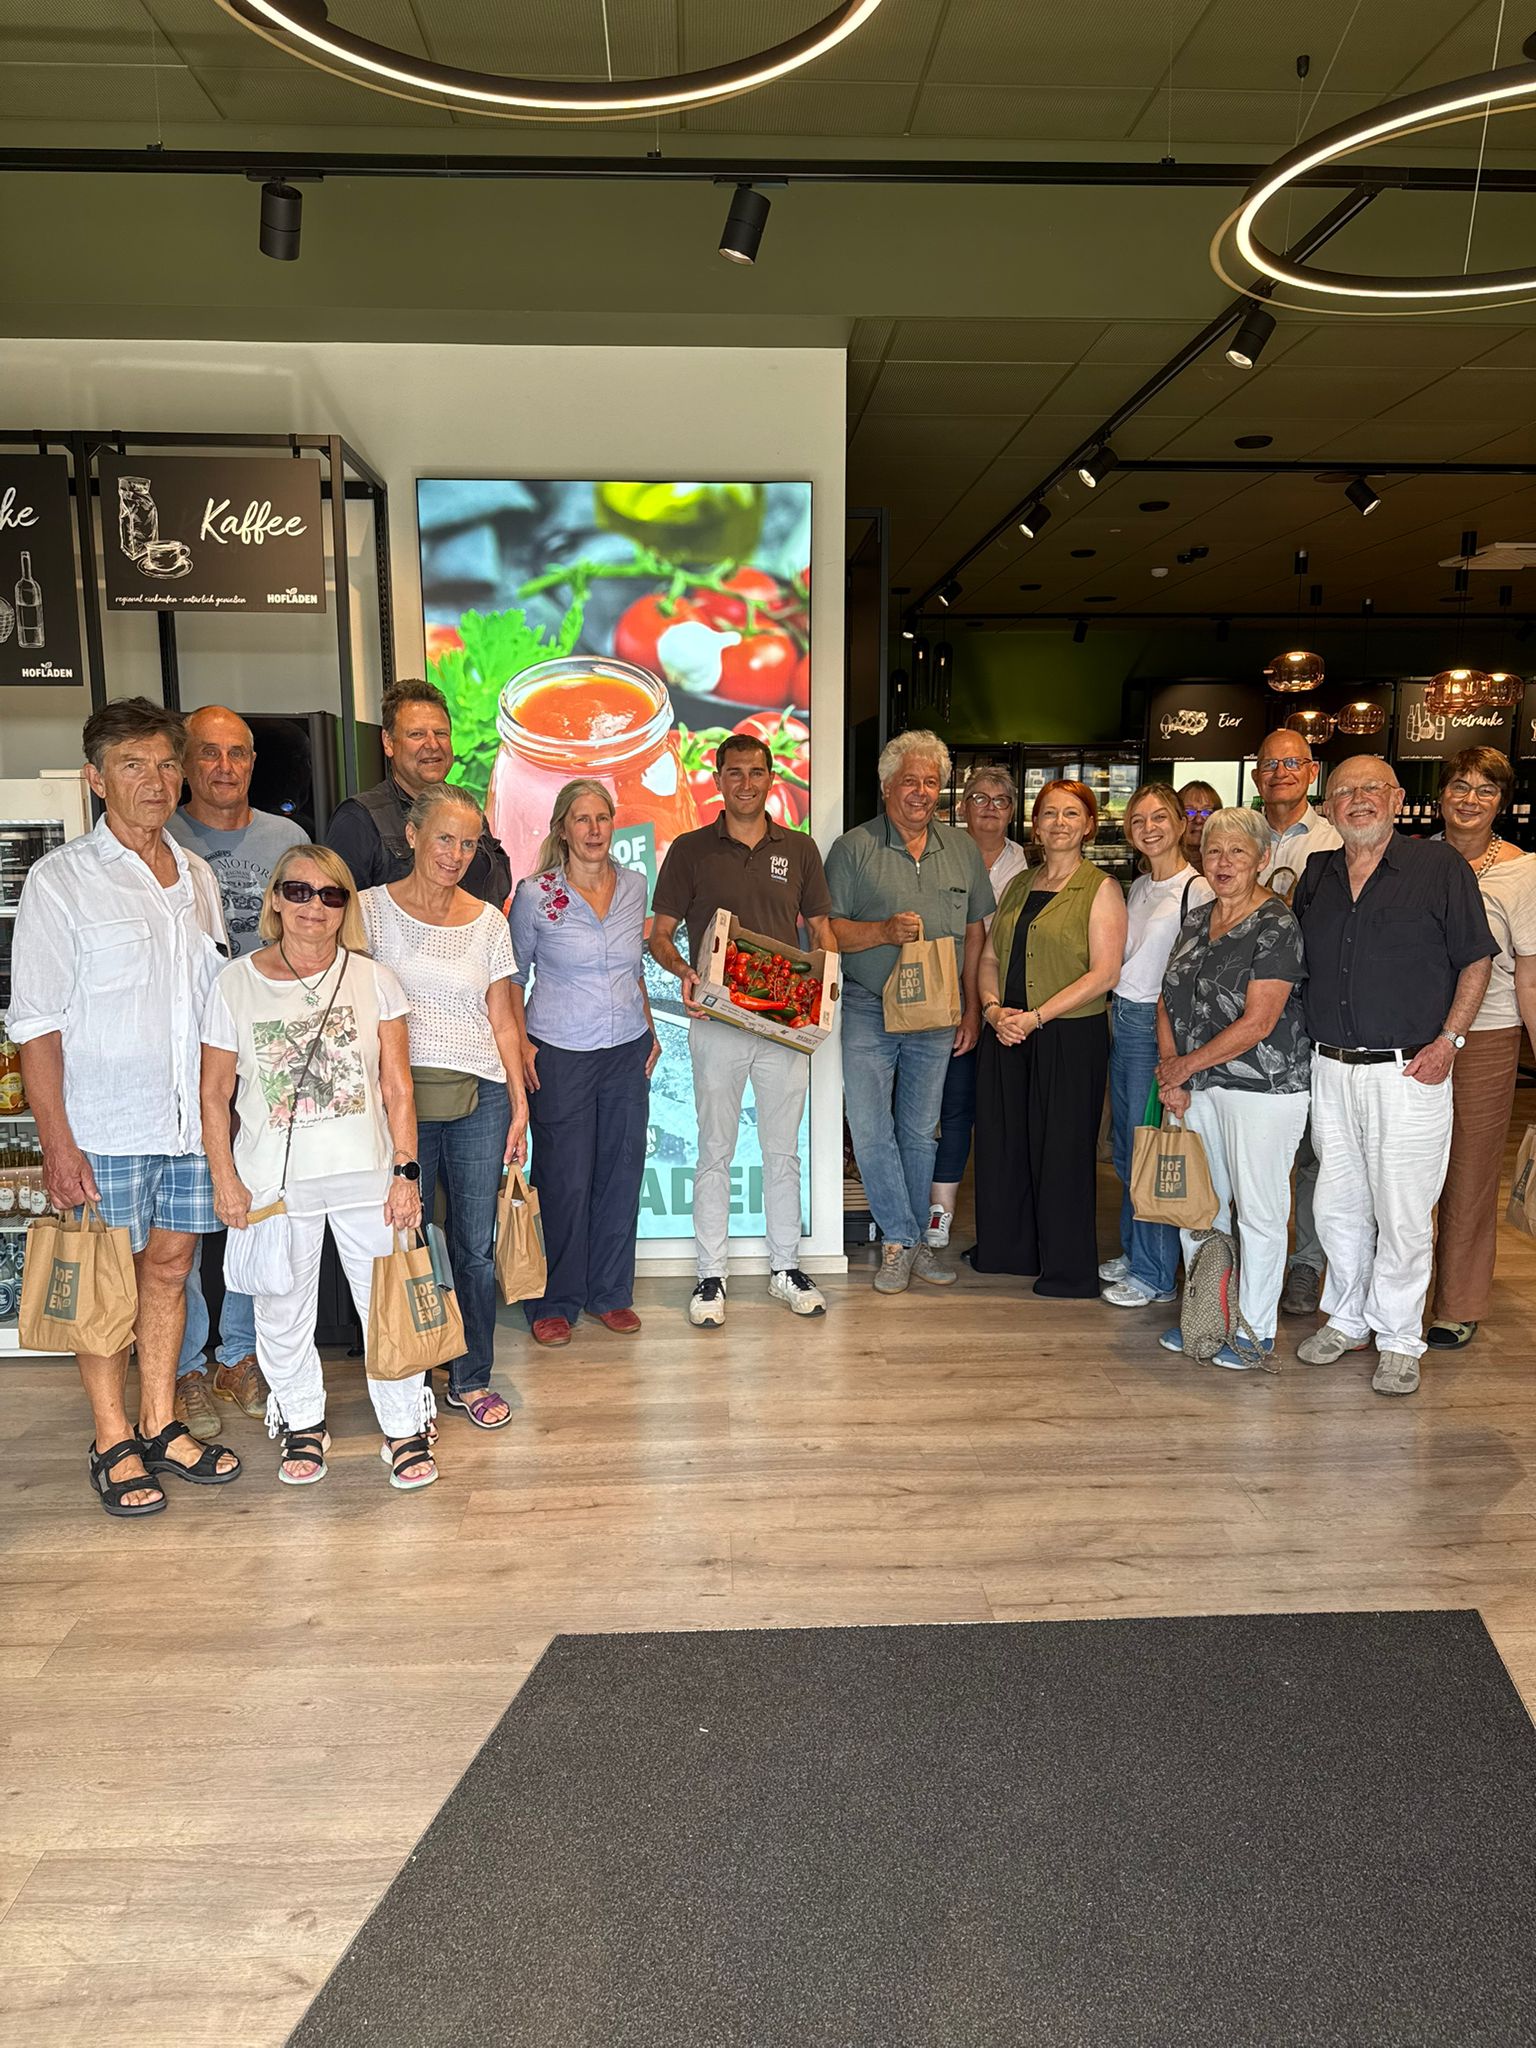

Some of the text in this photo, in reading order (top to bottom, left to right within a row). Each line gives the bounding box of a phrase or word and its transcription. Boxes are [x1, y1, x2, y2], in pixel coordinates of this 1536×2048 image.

[0, 487, 40, 532] ke
[200, 498, 308, 545] Kaffee
[115, 593, 143, 606] regional
[144, 594, 177, 604] einkaufen
[183, 594, 214, 604] natürlich
[267, 593, 318, 604] HOFLADEN
[22, 668, 73, 678] HOFLADEN
[1218, 712, 1243, 728] Eier
[1451, 711, 1504, 728] Getränke
[612, 835, 646, 865] OF
[770, 855, 789, 868] BIO
[771, 864, 788, 877] hof
[900, 967, 920, 978] HOF
[900, 977, 920, 988] LAD
[900, 988, 914, 999] EN
[1160, 1160, 1181, 1171] HOF
[1160, 1171, 1181, 1182] LAD
[638, 1166, 764, 1216] ADE
[1160, 1181, 1174, 1193] EN
[49, 1294, 62, 1310] EN
